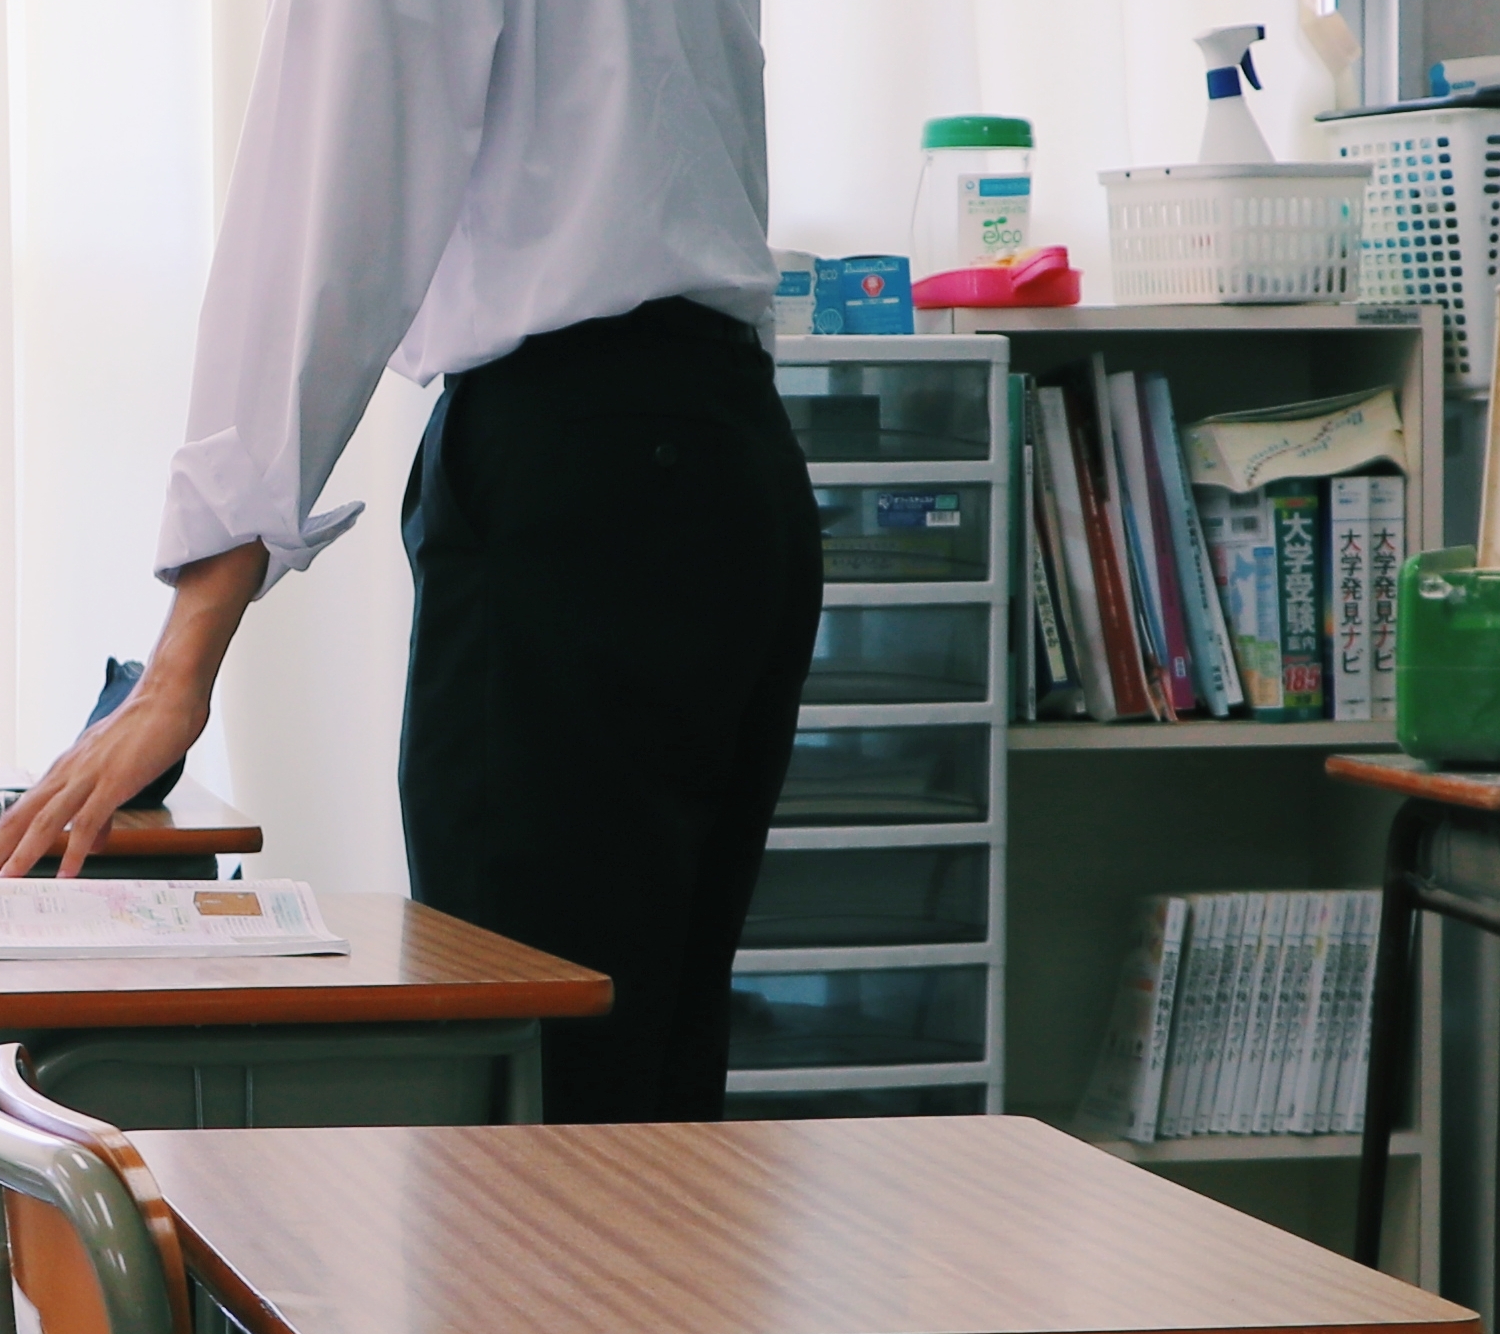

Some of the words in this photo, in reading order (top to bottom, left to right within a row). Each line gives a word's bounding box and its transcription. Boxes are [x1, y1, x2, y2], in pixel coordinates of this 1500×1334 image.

[1340, 528, 1363, 674] 大学発見ナビ
[1373, 527, 1397, 673] 大学発見ナビ
